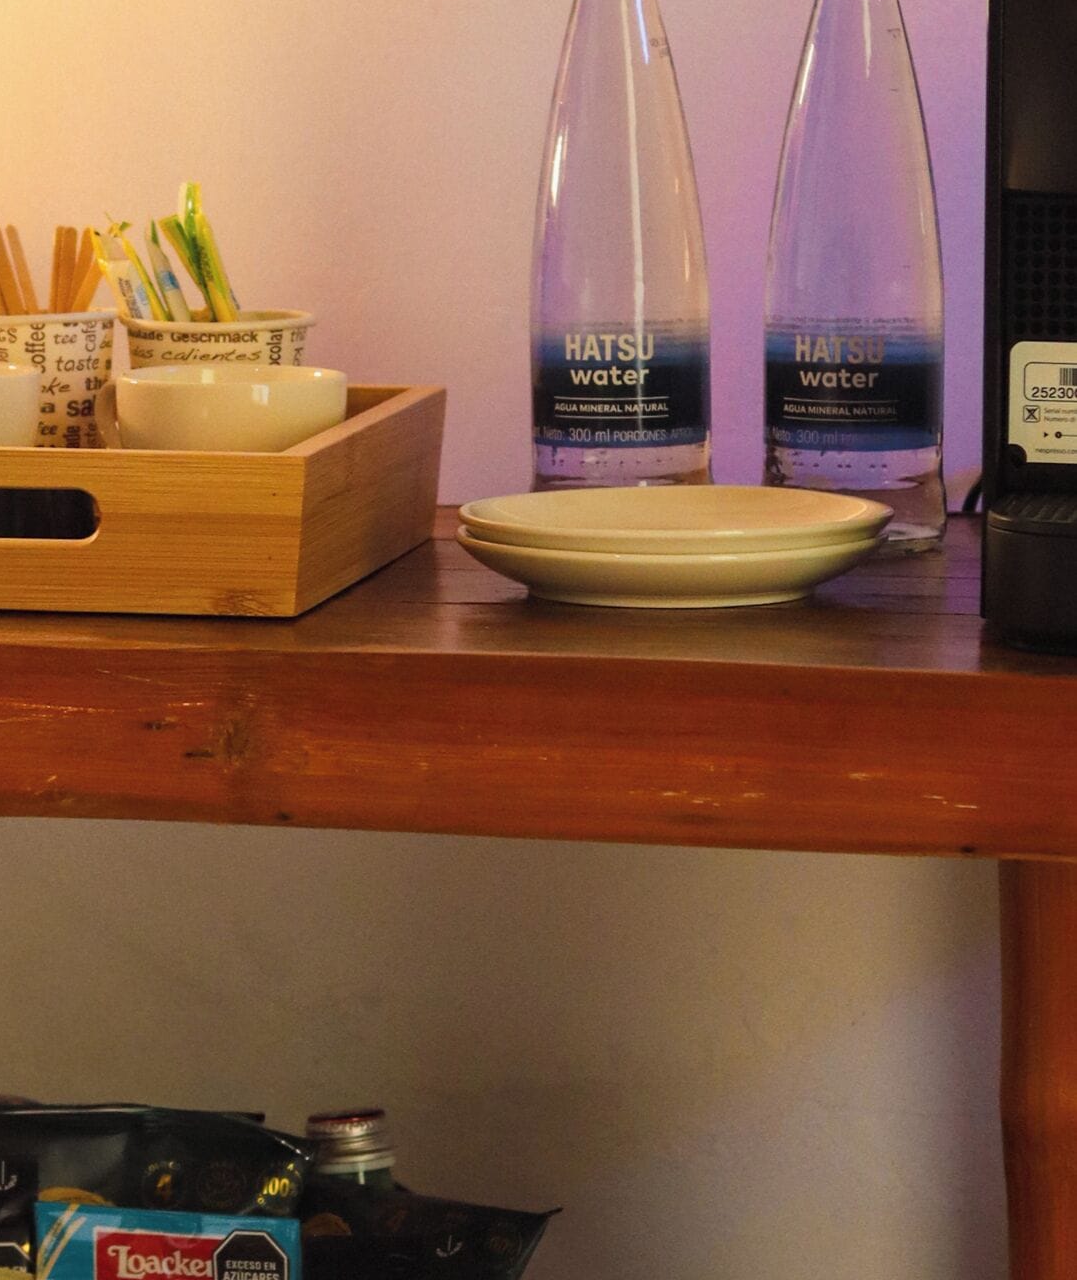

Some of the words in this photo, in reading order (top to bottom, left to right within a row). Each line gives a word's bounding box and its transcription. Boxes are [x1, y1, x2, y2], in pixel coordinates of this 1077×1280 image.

[171, 331, 259, 343] Geschmack
[565, 333, 655, 362] HATSU
[795, 334, 886, 364] HATSU
[161, 348, 262, 362] calientes
[56, 356, 100, 372] taste
[571, 366, 650, 385] water
[799, 369, 879, 388] water
[554, 402, 578, 412] AGUA
[579, 403, 622, 413] MINERAL
[624, 402, 669, 413] NATURAL
[783, 404, 806, 413] AGUA
[808, 405, 851, 415] MINERAL
[853, 406, 897, 415] NATURAL
[569, 427, 591, 441] 300
[595, 428, 610, 441] ml
[796, 429, 819, 444] 300
[823, 431, 838, 444] ml
[225, 1260, 262, 1270] EXCESO
[264, 1261, 277, 1271] EN
